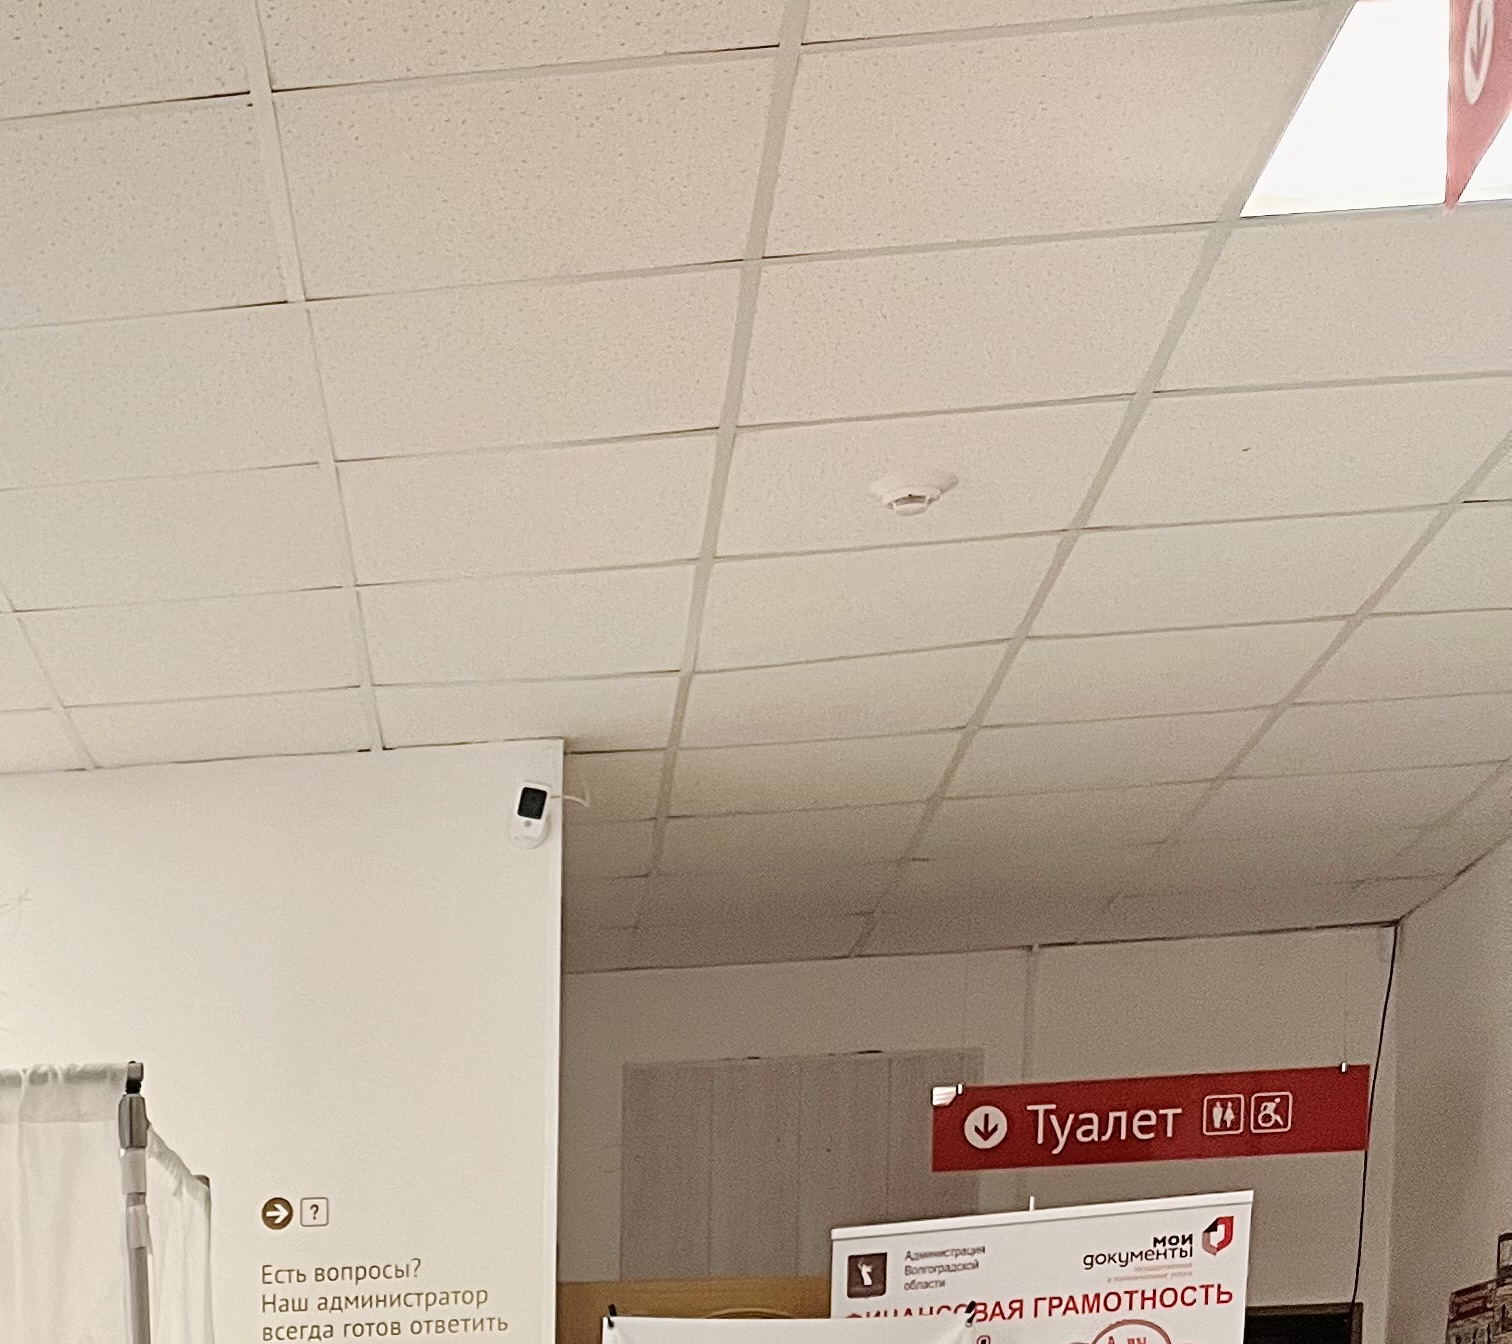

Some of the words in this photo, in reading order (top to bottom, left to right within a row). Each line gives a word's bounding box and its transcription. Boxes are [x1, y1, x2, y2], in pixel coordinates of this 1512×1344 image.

[1026, 1103, 1183, 1155] Туалет
[904, 1246, 986, 1261] Администрация
[1152, 1233, 1194, 1249] мои
[904, 1259, 979, 1276] Волгоградской
[1082, 1246, 1194, 1271] документы
[261, 1264, 307, 1285] Есть
[314, 1257, 422, 1286] вопросы?
[904, 1279, 946, 1291] области
[261, 1293, 309, 1314] Наш
[316, 1288, 489, 1313] администратор
[1033, 1283, 1234, 1319] ГРАМОТНОСТЬ
[262, 1322, 335, 1343] всегда
[342, 1320, 402, 1339] готов
[409, 1315, 509, 1336] ответить
